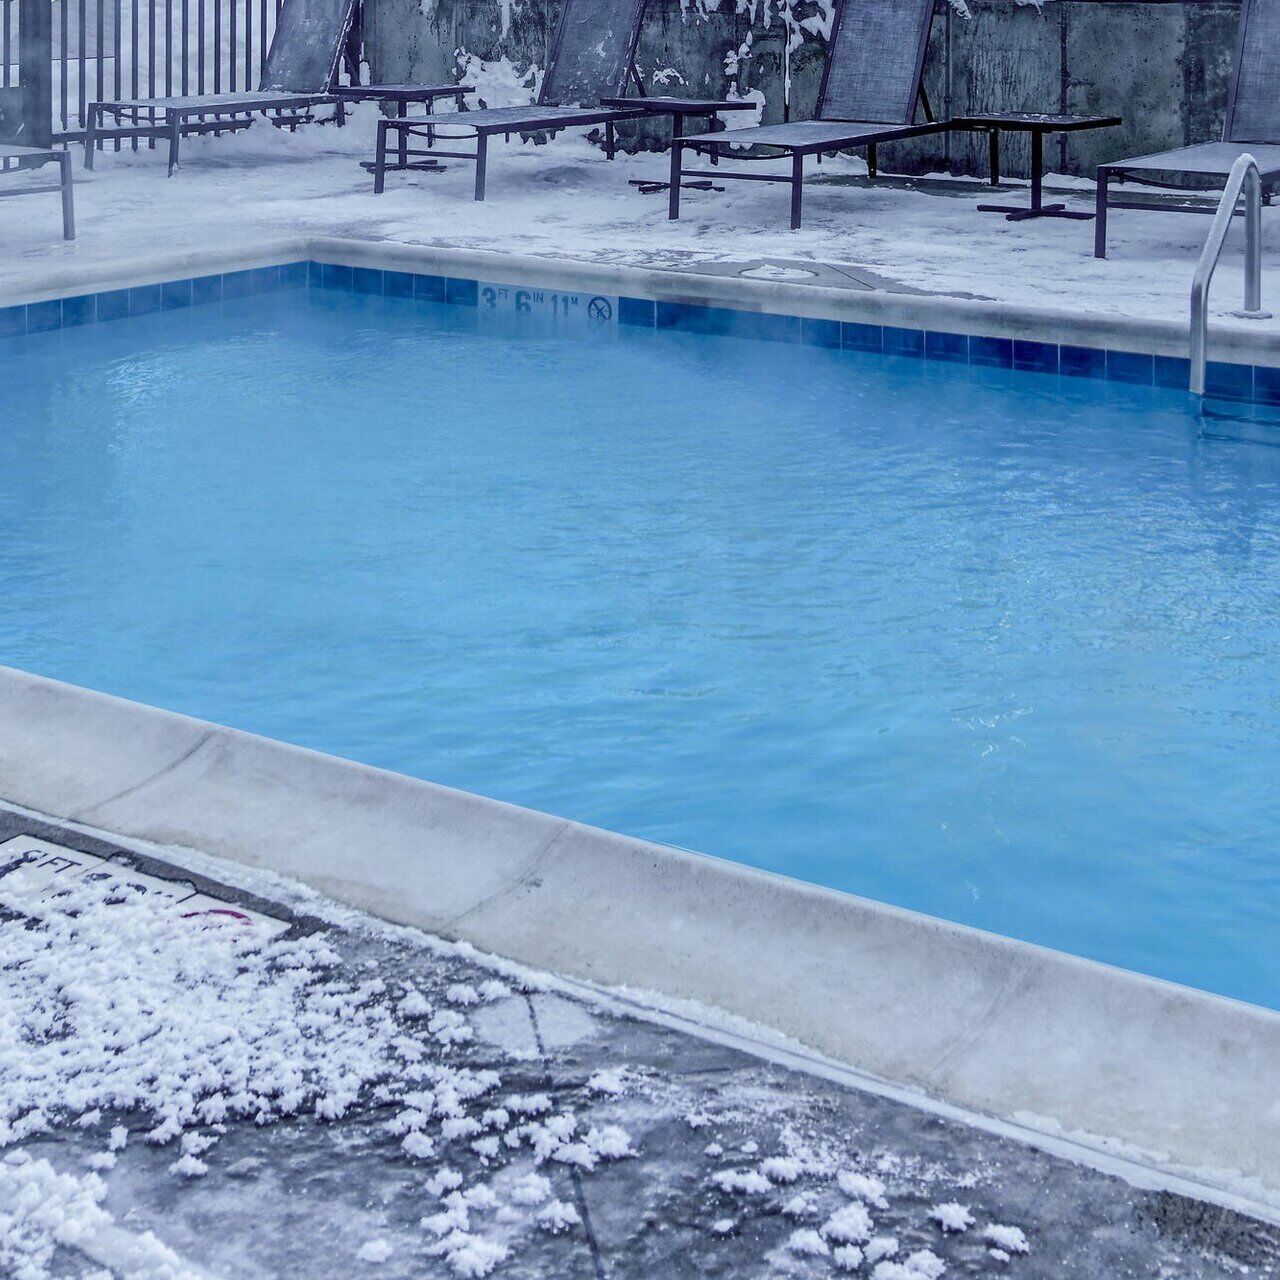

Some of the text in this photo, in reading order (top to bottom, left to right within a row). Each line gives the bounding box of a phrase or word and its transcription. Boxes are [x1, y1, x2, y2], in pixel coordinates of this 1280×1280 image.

[498, 288, 509, 300] FT
[515, 290, 532, 312] 6
[533, 292, 544, 303] IN
[571, 296, 579, 305] M
[37, 856, 82, 874] FT
